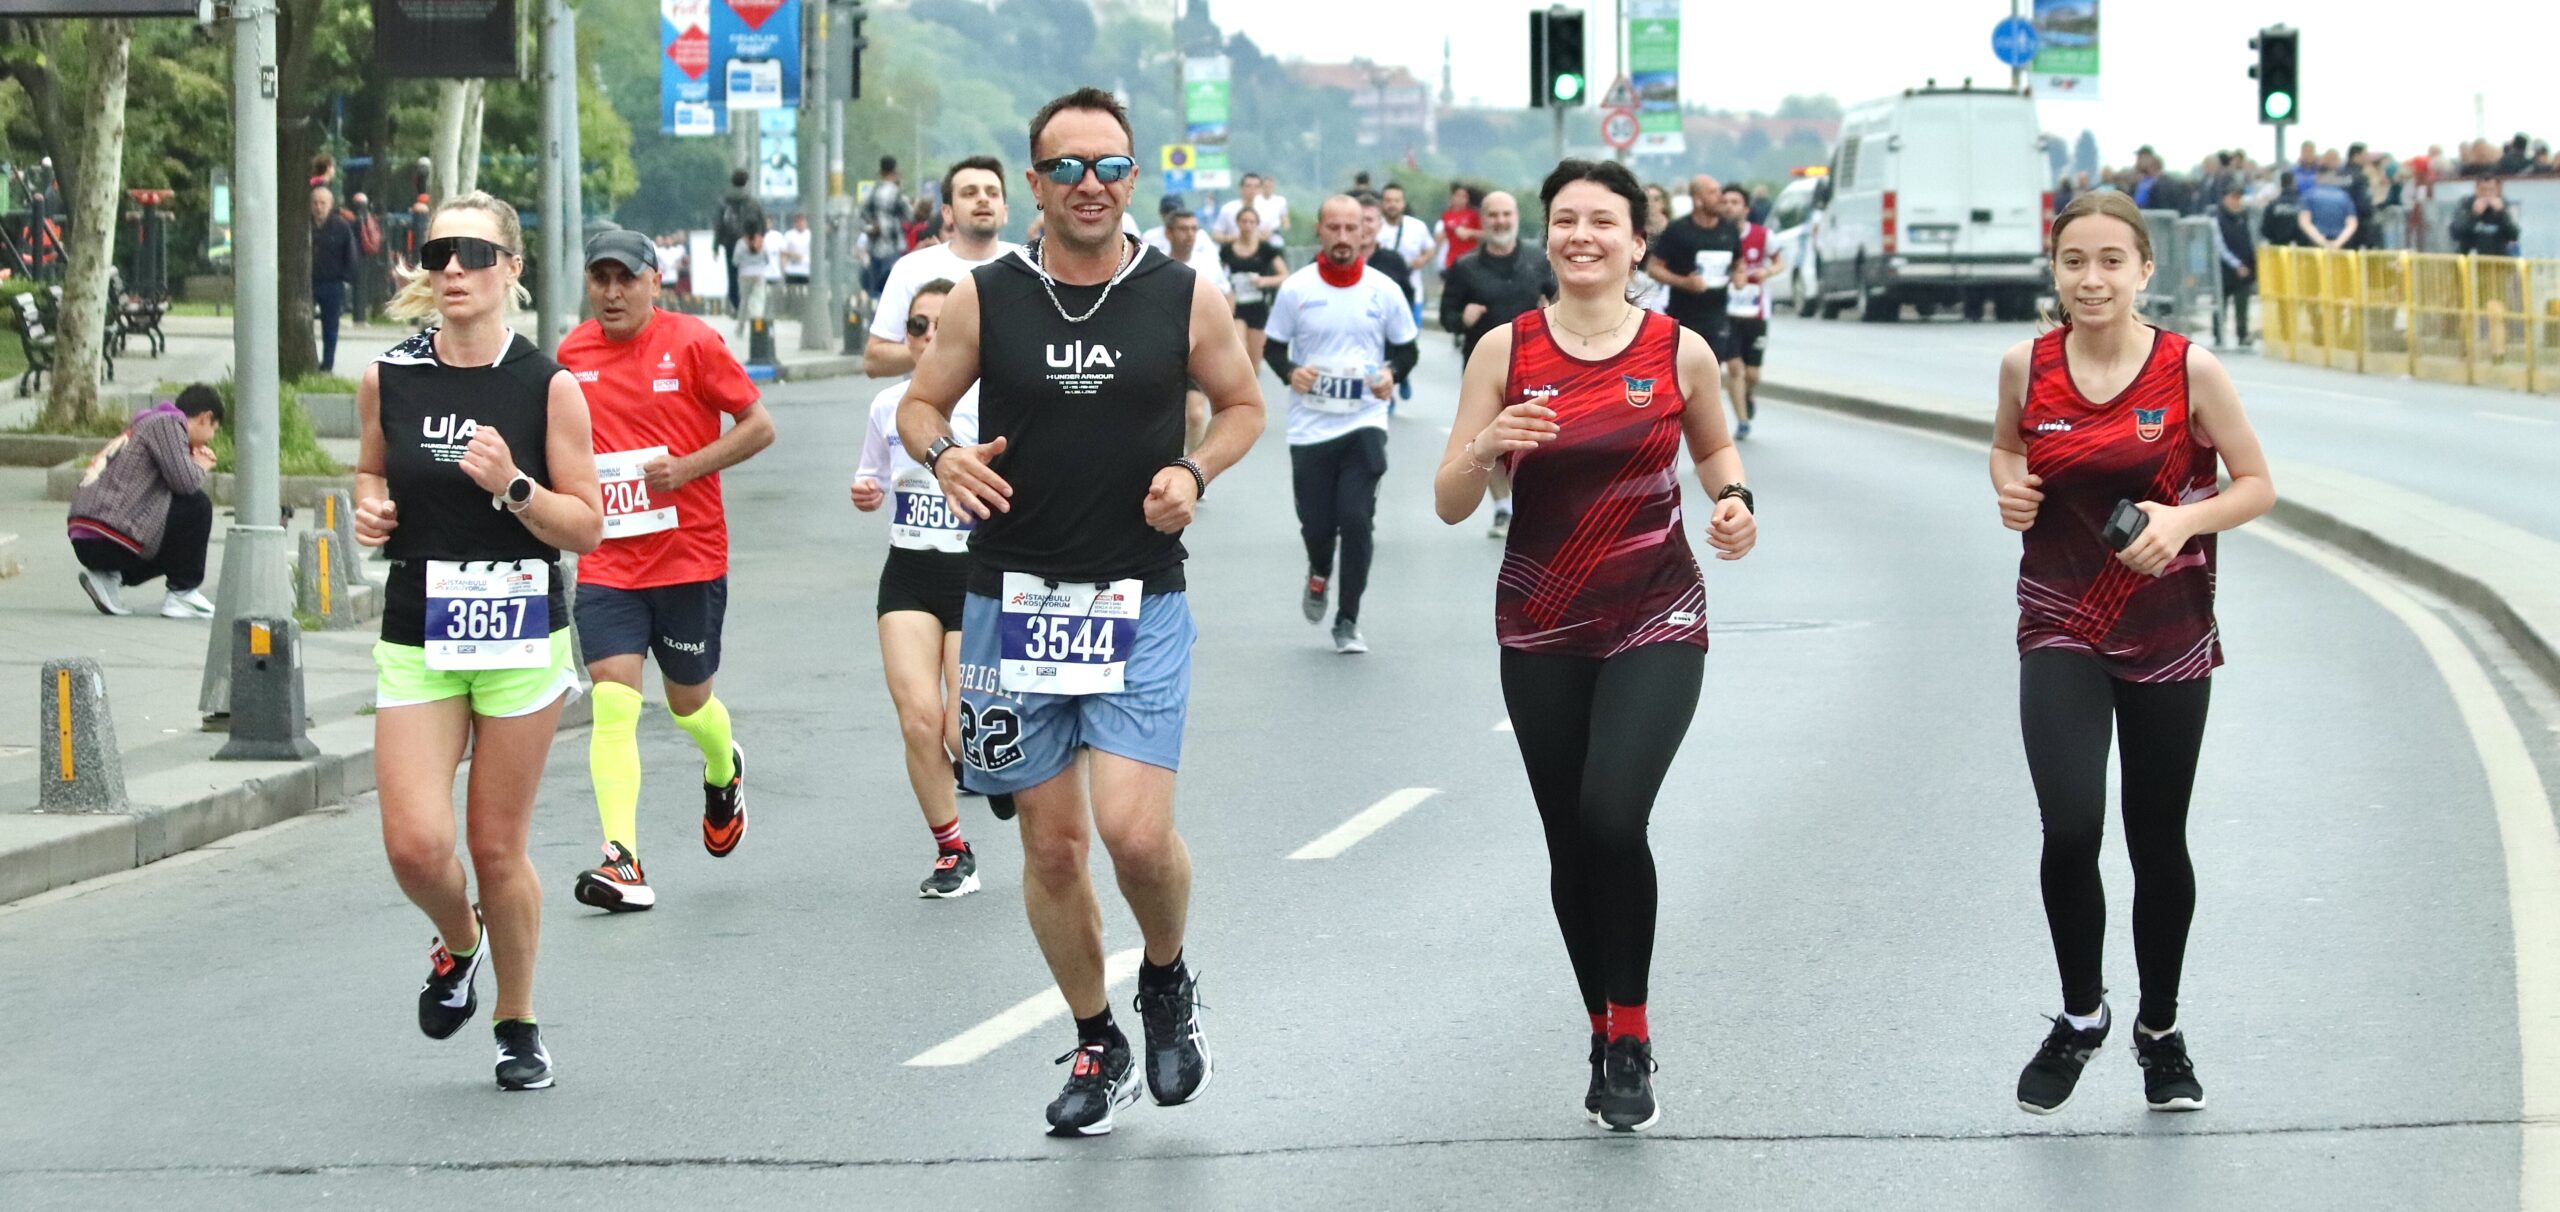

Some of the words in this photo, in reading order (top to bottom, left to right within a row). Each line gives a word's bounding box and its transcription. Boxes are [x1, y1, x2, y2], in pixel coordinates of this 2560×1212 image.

[1312, 376, 1352, 399] 4211
[604, 480, 651, 514] 204
[447, 598, 527, 639] 3657
[1025, 615, 1115, 662] 3544
